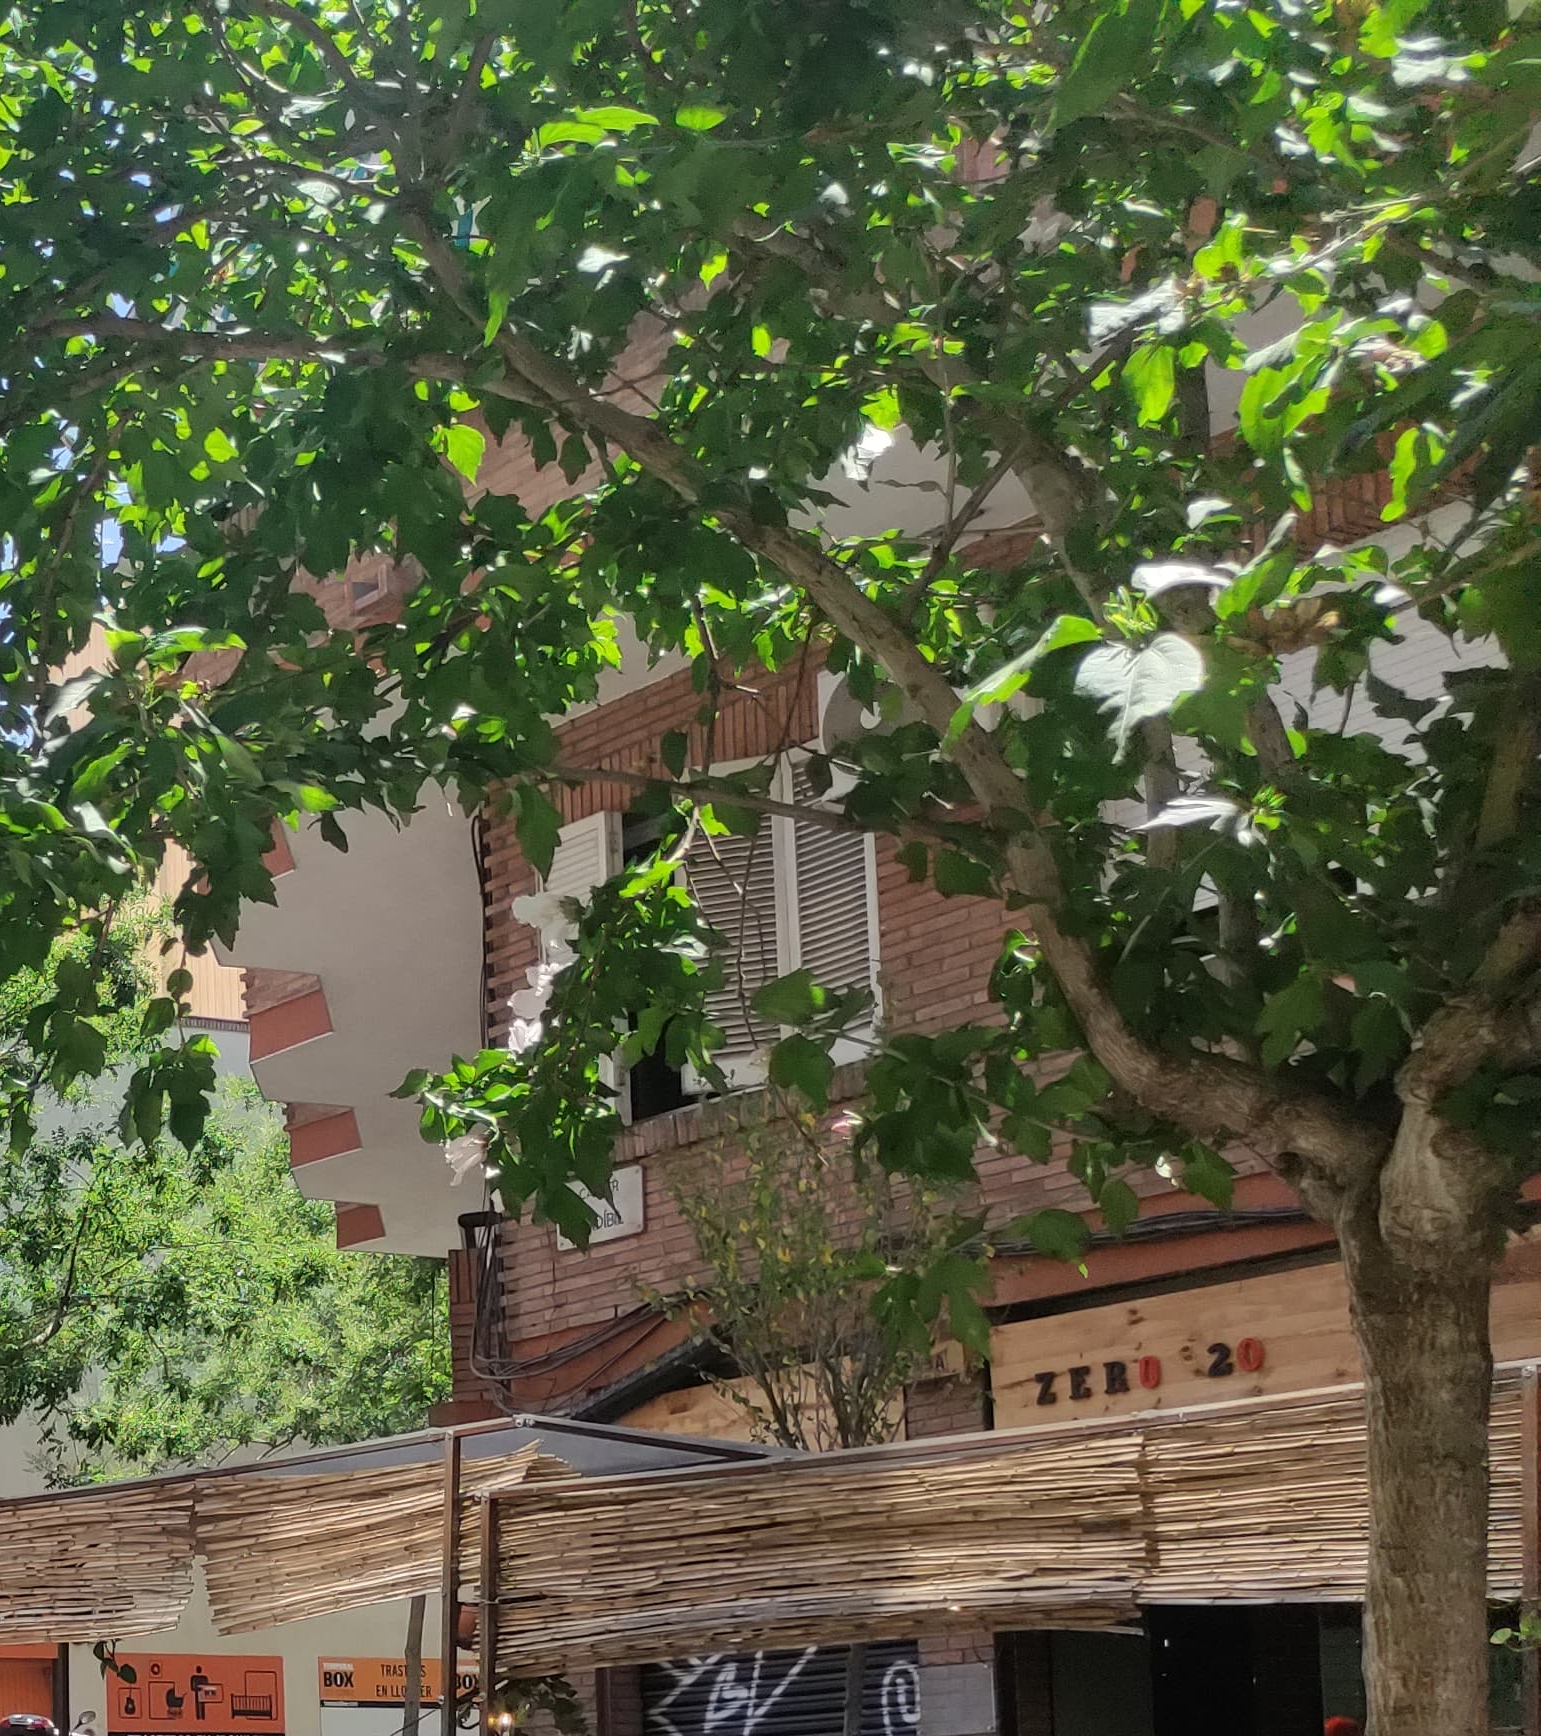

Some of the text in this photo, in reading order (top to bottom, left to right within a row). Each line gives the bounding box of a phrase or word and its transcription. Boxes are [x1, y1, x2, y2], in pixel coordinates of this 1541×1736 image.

[1035, 1337, 1265, 1405] ZERO 20
[323, 1671, 354, 1688] BOX
[376, 1685, 388, 1697] EN
